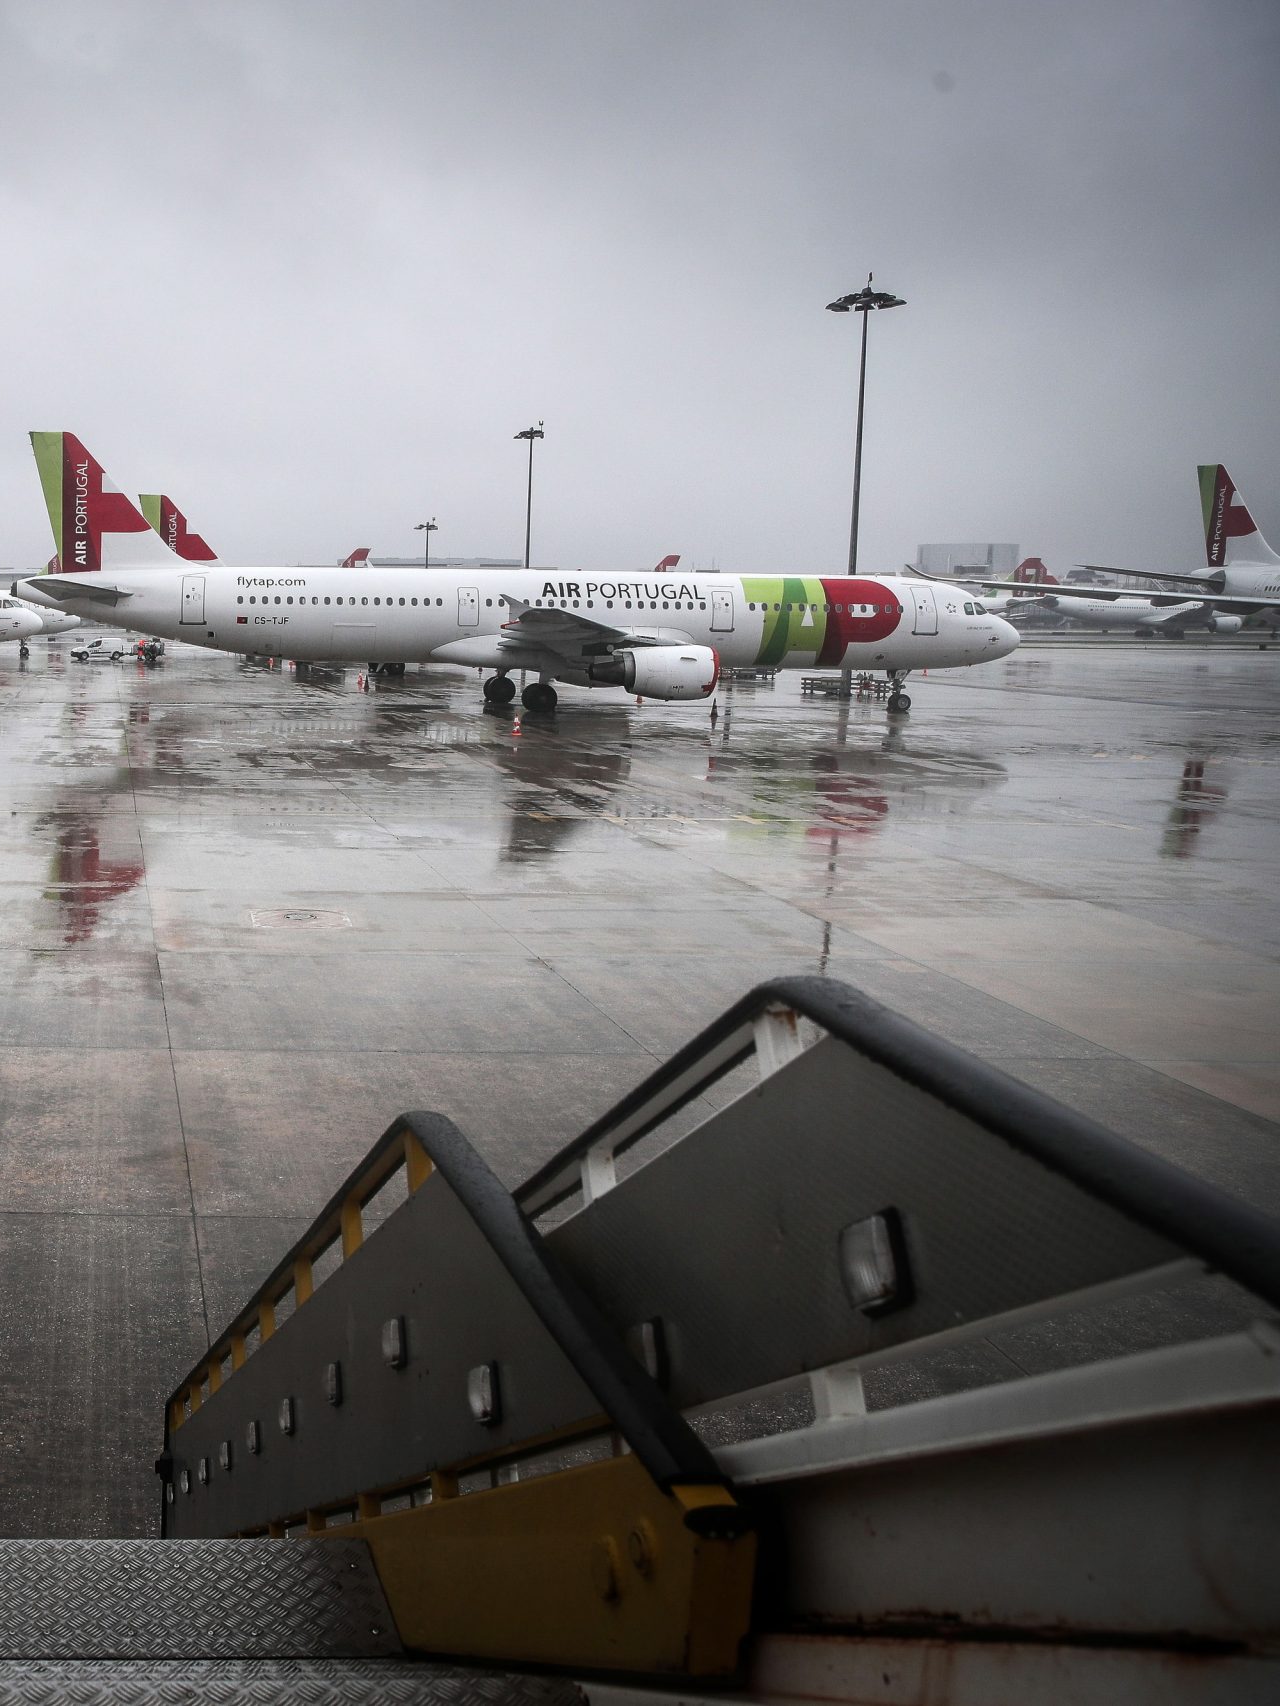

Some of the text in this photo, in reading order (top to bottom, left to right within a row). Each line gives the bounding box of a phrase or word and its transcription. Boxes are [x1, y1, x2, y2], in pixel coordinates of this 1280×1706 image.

[75, 459, 89, 565] AIR PORTUGAL
[1211, 485, 1227, 561] AIR PORTUGAL
[236, 576, 306, 588] flytap.com
[542, 582, 707, 600] AIR PORTUGAL
[254, 616, 290, 625] CS-TJF
[739, 577, 902, 667] TAP
